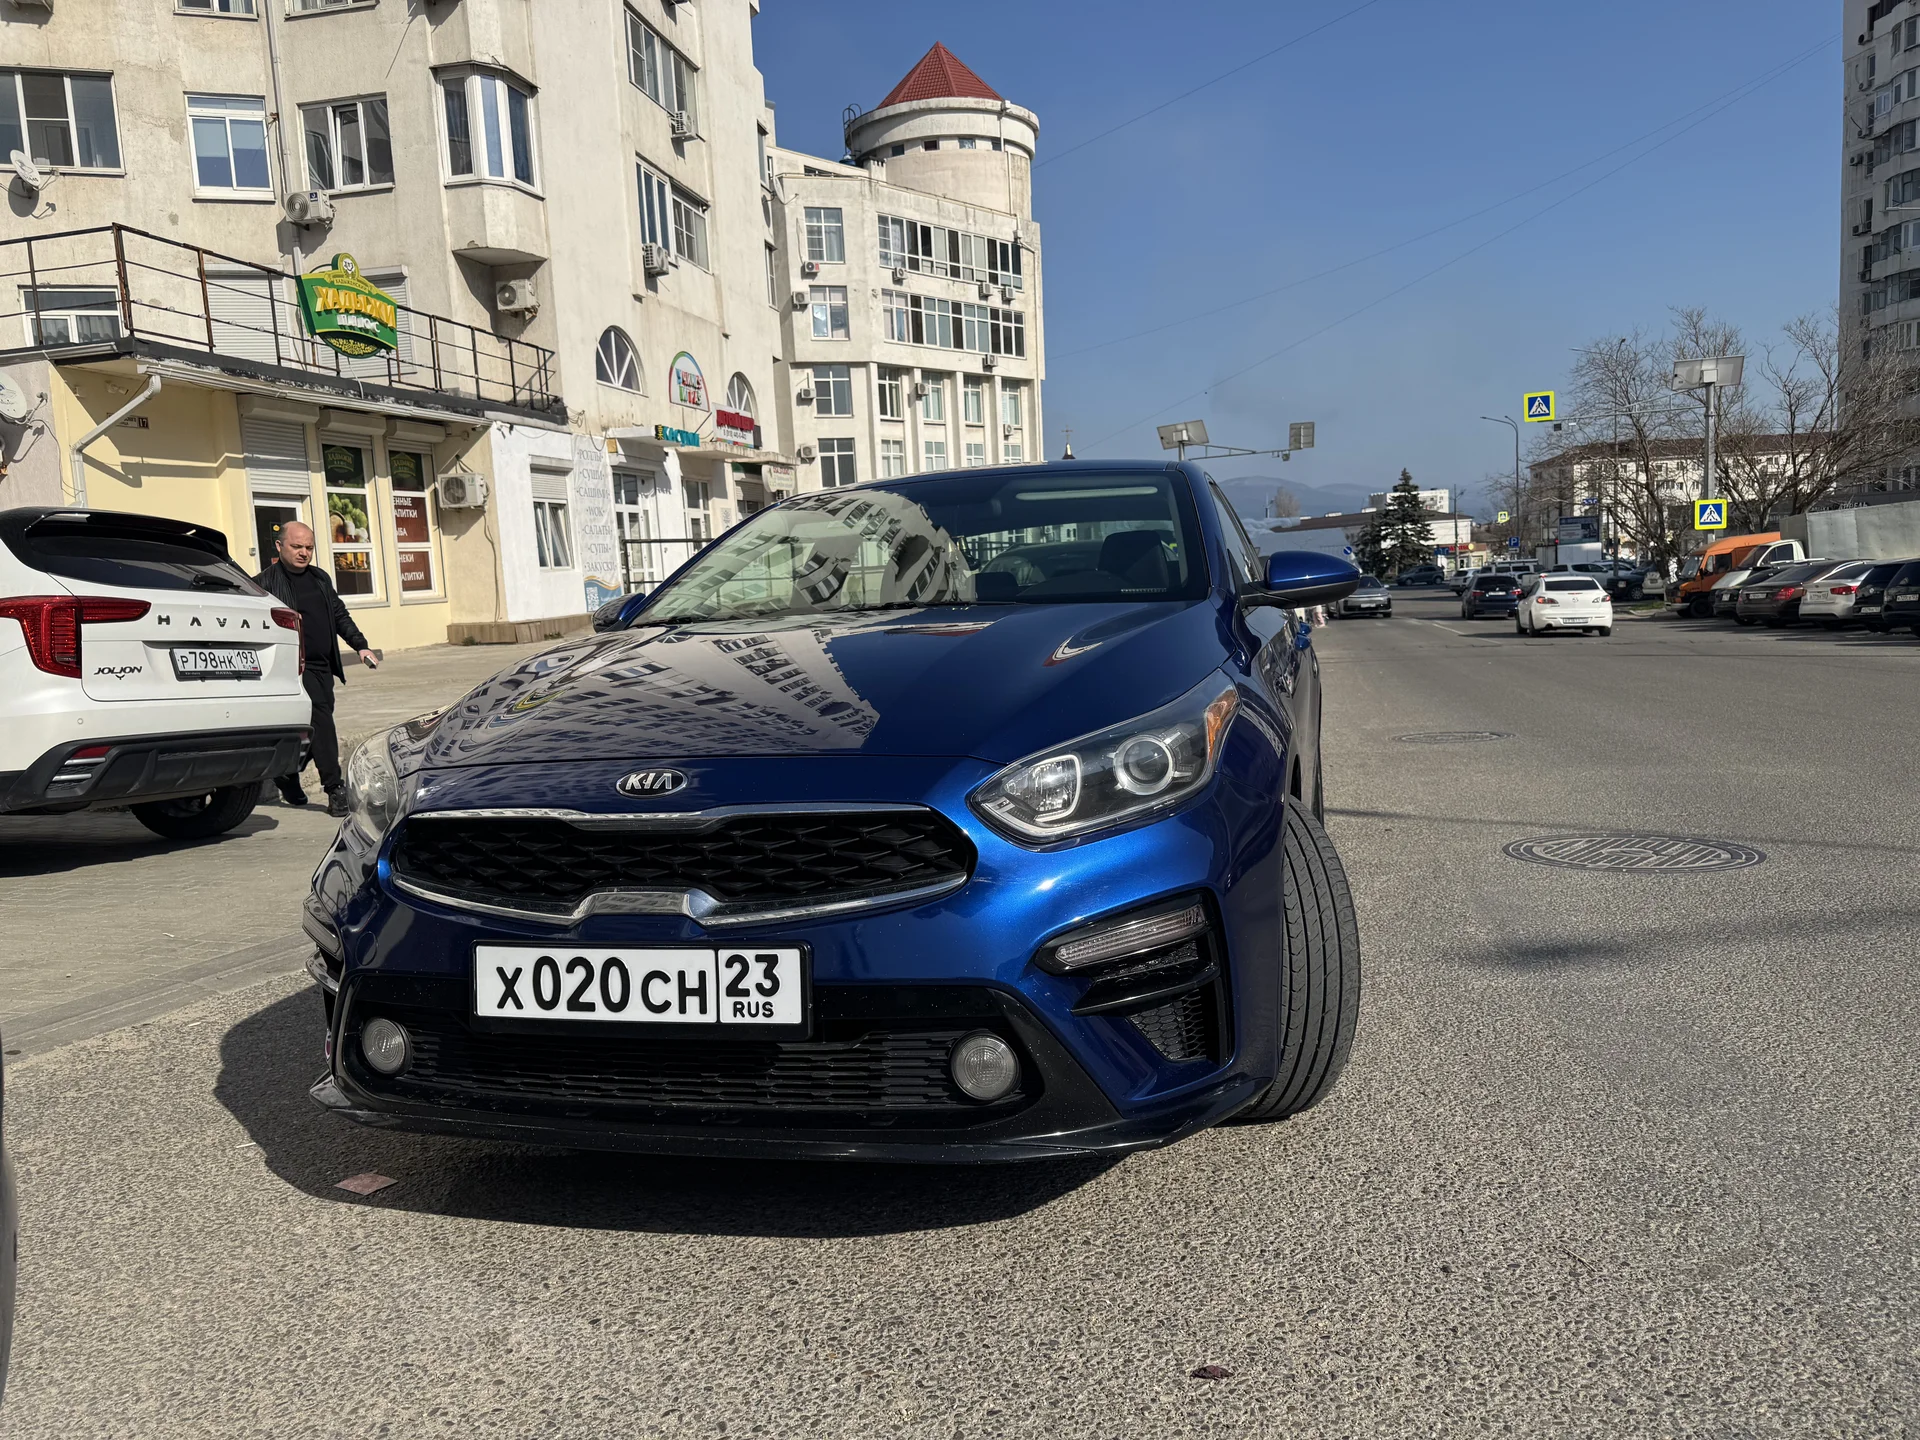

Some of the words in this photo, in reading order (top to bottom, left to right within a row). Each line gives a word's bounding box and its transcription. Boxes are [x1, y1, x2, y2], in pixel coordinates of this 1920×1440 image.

[313, 286, 396, 329] ХАДЫЖИ
[337, 314, 380, 333] ПЛЮС
[139, 418, 147, 428] 17
[579, 449, 602, 462] РОЛЛЫ
[581, 468, 603, 481] СУШИ
[578, 487, 609, 500] САШИМИ
[588, 506, 604, 517] WOK
[583, 524, 611, 540] САЛАТЫ
[589, 543, 609, 556] СУПЫ
[586, 561, 616, 574] ЗАКУСКИ
[157, 614, 270, 630] HAVAL
[236, 651, 257, 665] 193
[93, 665, 143, 677] JOLION
[625, 776, 673, 790] KIA
[725, 953, 781, 998] 23
[732, 1001, 775, 1018] RUS
